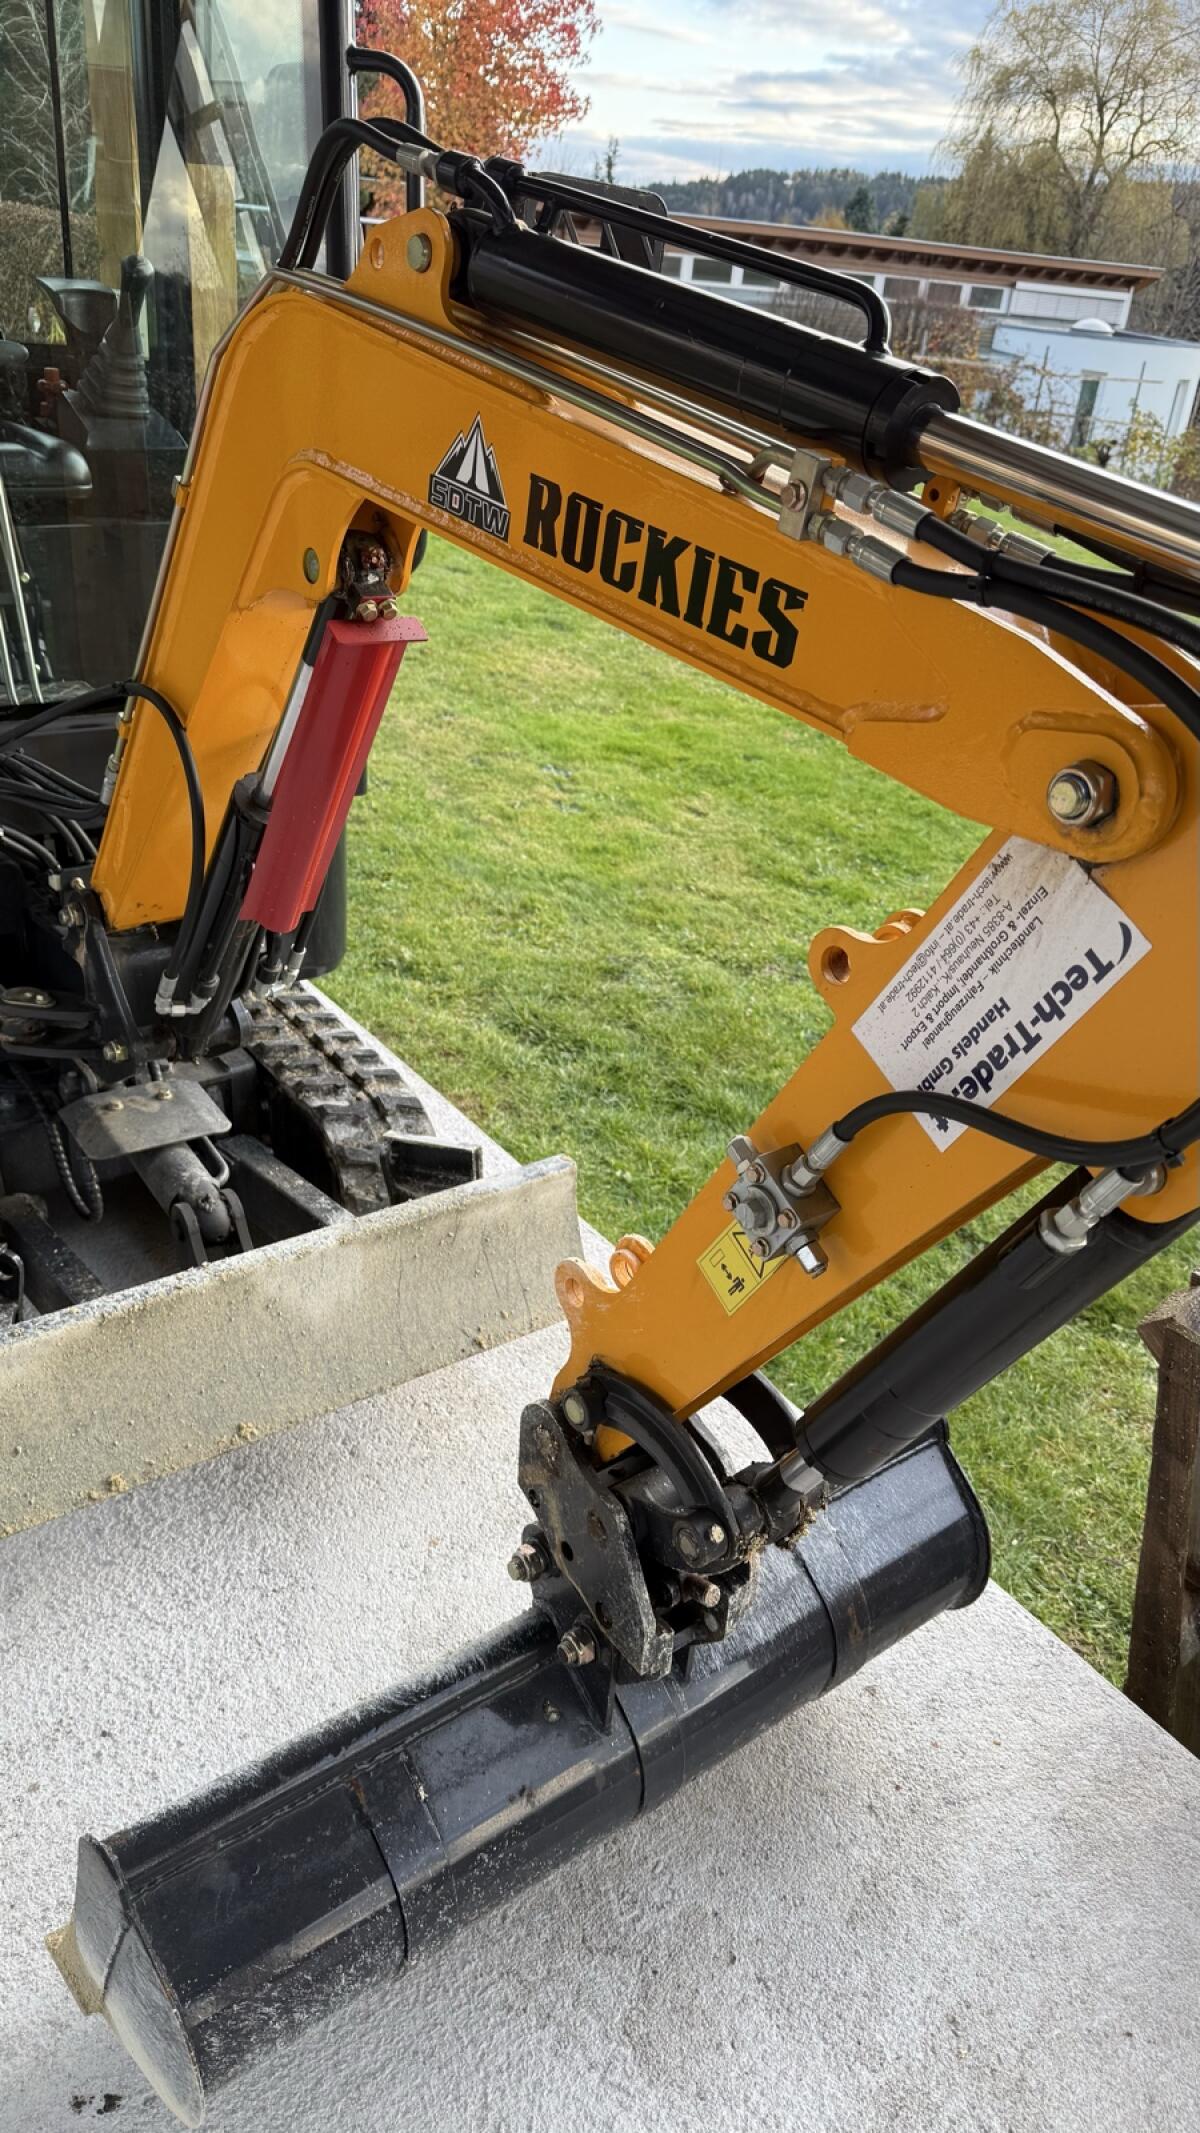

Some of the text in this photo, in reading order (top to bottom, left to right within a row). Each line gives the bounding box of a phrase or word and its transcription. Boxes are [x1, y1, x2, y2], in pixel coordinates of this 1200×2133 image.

[523, 472, 809, 669] ROCKIES
[939, 929, 967, 966] (0)664
[963, 915, 981, 936] +43
[981, 899, 1013, 939] A-8385
[987, 915, 1045, 976] Landtechnik
[876, 938, 942, 1016] info@tech-trade.at
[899, 885, 1049, 1052] Einzel- & Großhandel, Import & Export
[904, 964, 937, 1004] 4112992
[911, 1006, 921, 1018] 2
[921, 979, 985, 1051] Fahrzeughandel
[929, 947, 1116, 1133] Tech-Trade.t
[951, 995, 1012, 1061] Handels
